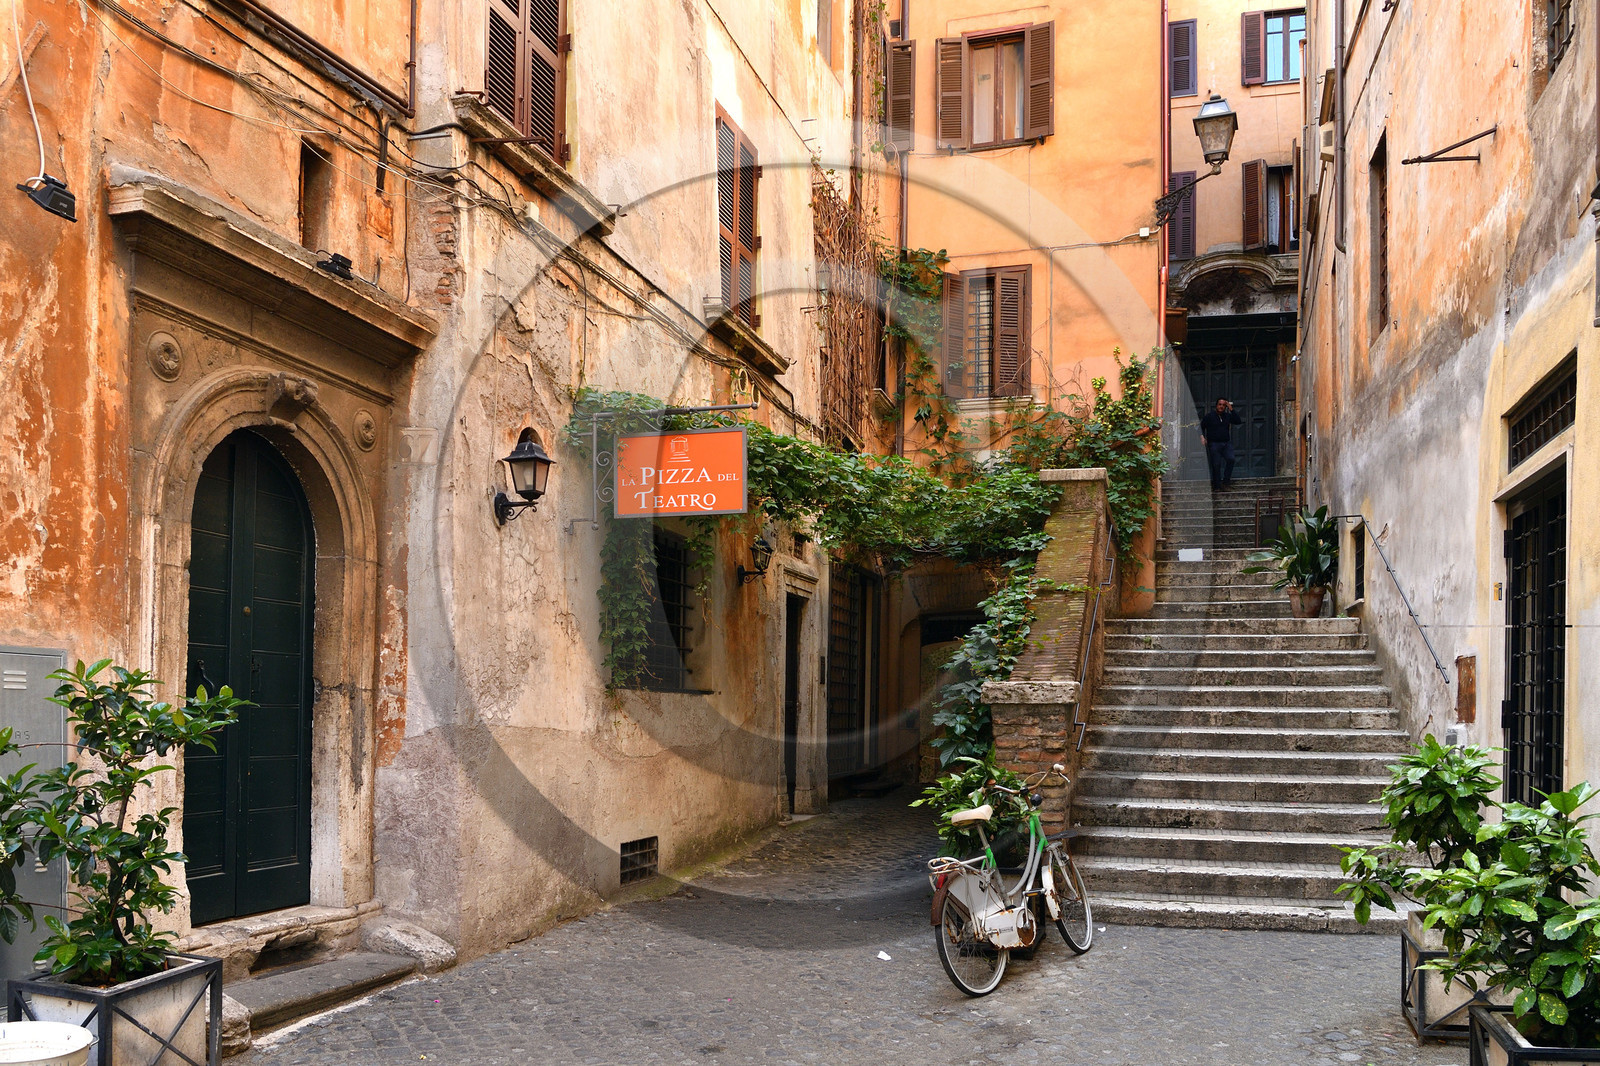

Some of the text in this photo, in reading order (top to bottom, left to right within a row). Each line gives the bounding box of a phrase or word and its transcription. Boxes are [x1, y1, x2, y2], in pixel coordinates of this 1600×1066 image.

[621, 466, 740, 487] LA PIZZA DEL
[633, 487, 717, 511] TEATRO
